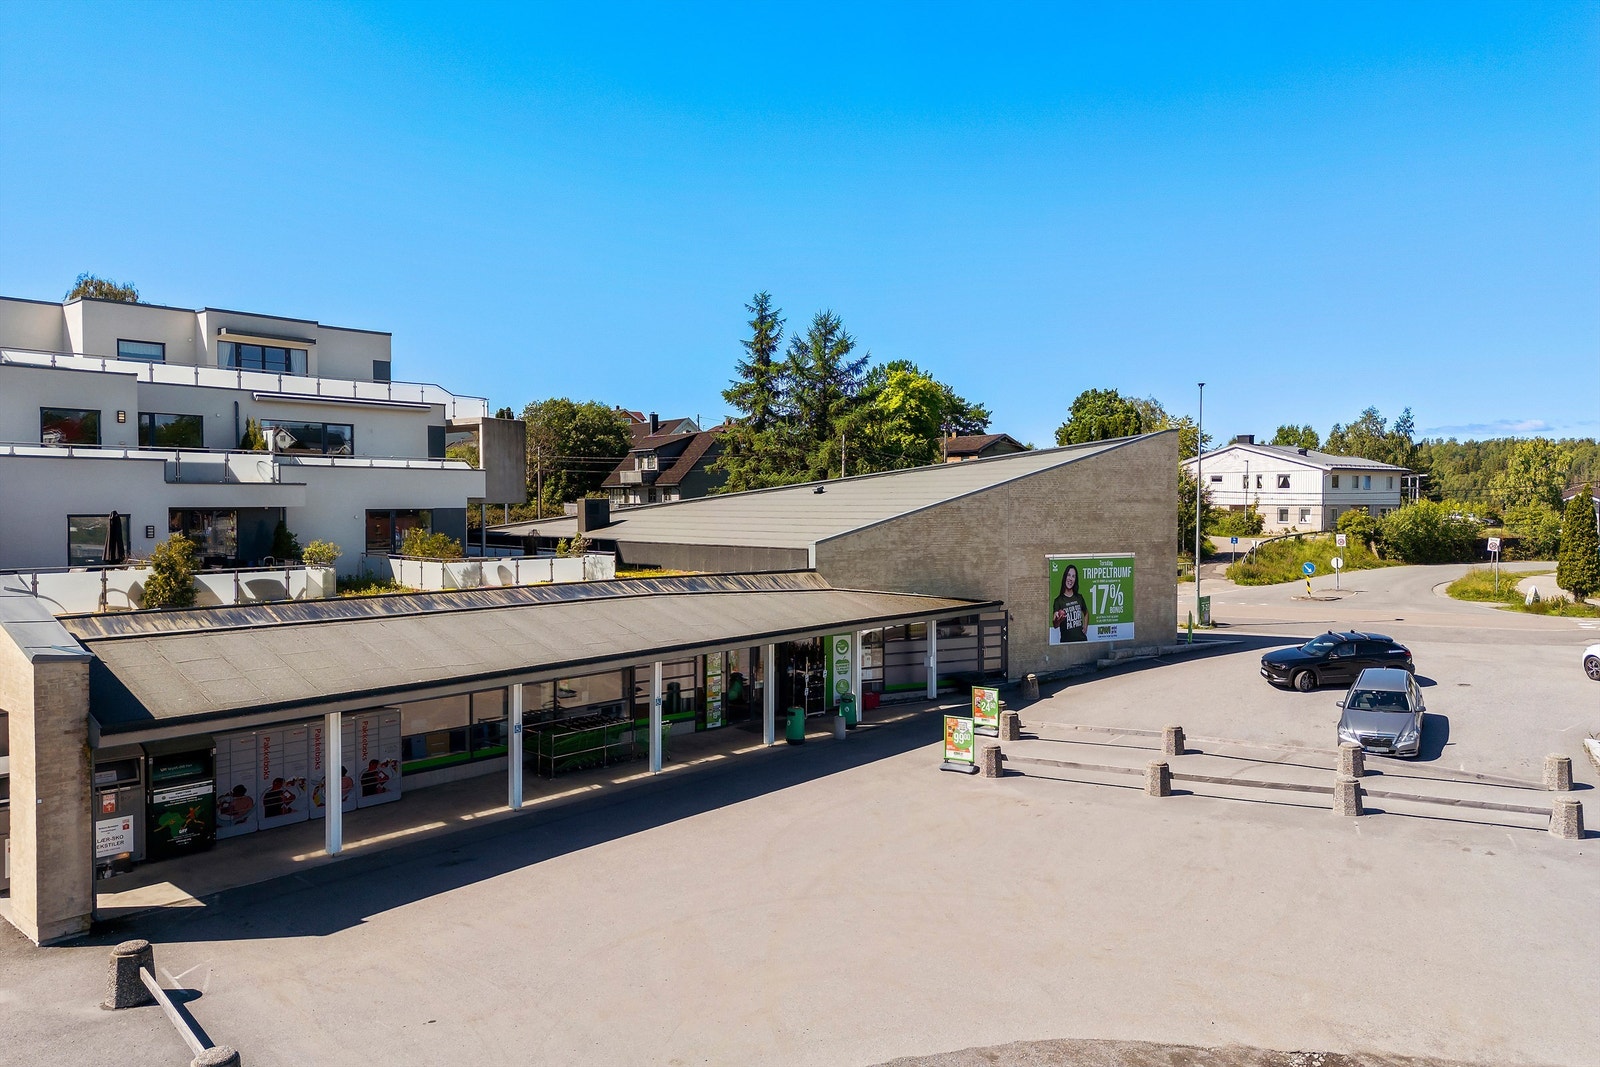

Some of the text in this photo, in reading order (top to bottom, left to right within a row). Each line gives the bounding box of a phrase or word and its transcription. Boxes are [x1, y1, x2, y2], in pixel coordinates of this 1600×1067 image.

[1083, 567, 1132, 579] TRIPPELTRUMF
[1090, 584, 1124, 614] 17%
[1109, 606, 1124, 614] BONUS
[263, 736, 271, 780] Pakkeboks
[96, 834, 124, 843] LÆR-SKO
[96, 840, 125, 850] EKSTILER
